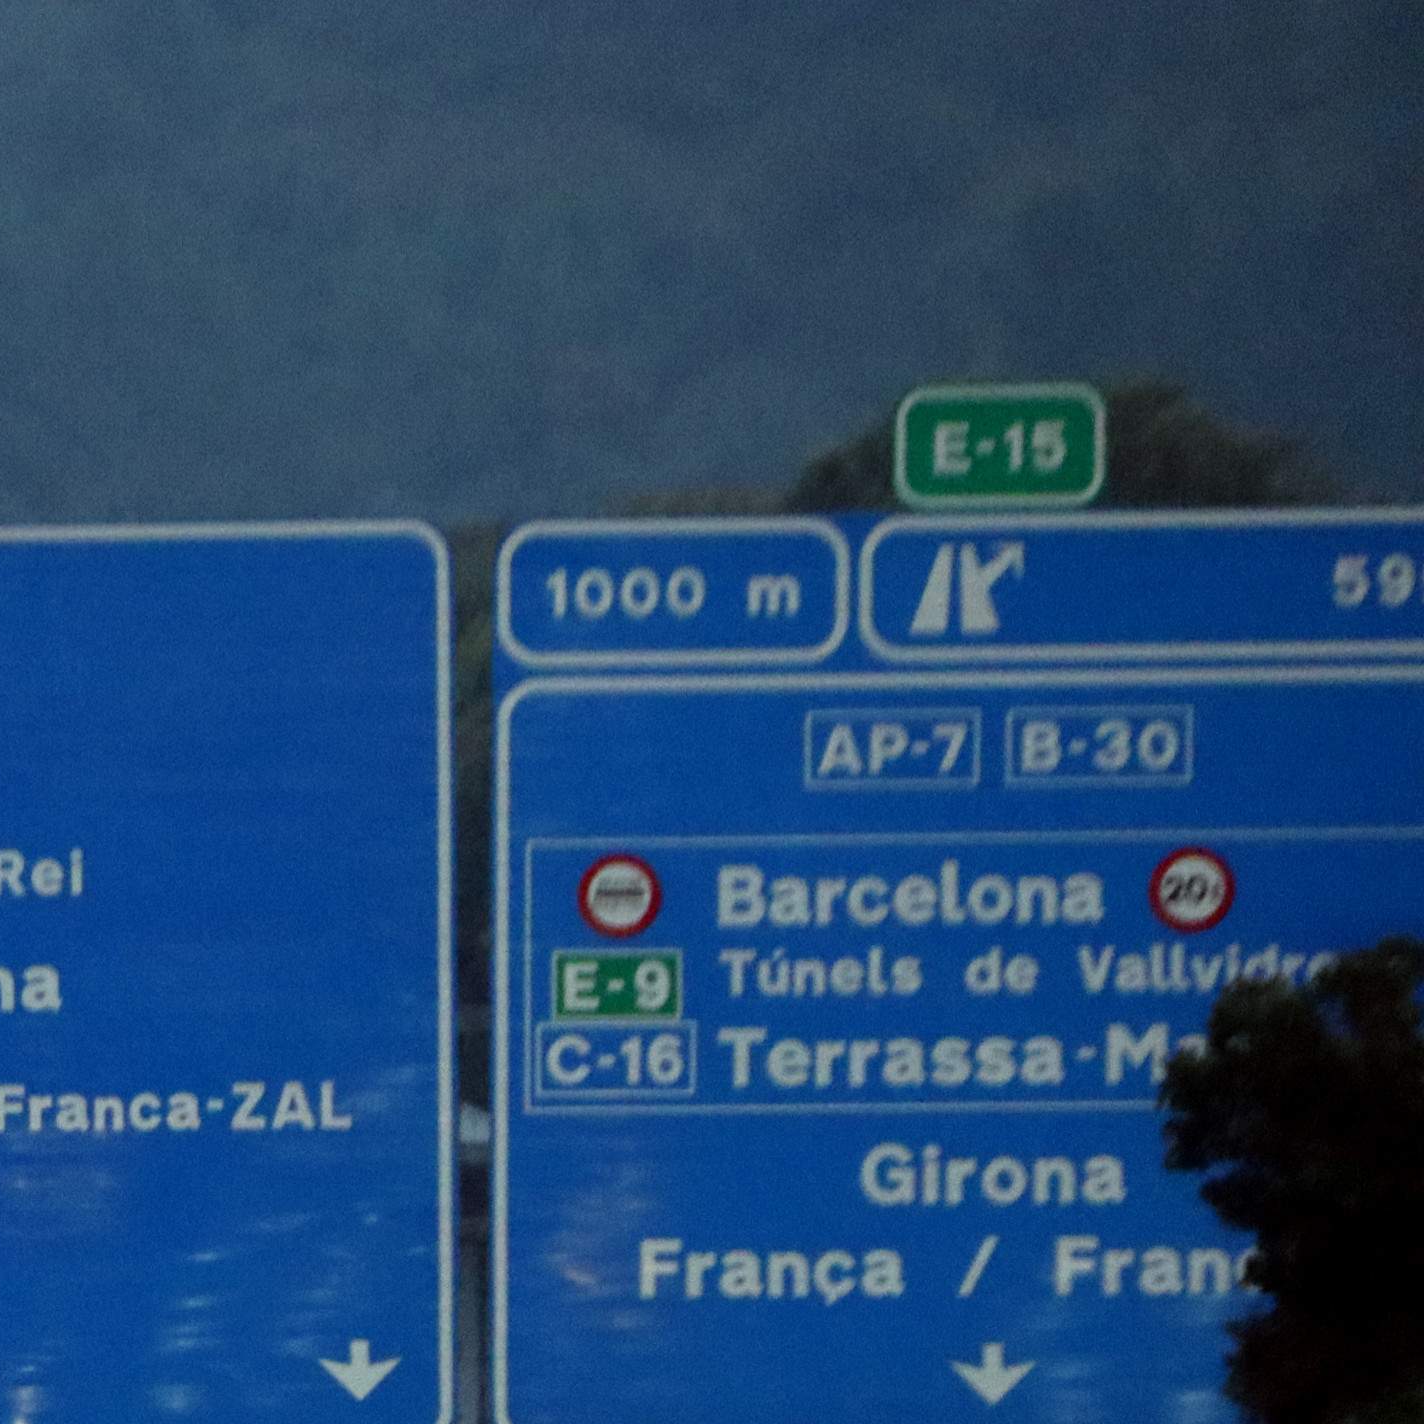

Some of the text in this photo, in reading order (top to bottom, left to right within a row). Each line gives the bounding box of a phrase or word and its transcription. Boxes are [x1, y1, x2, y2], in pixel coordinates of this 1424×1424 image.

[932, 420, 1068, 475] E-15
[545, 565, 802, 620] 1000 m
[1331, 551, 1424, 608] 59
[817, 721, 968, 777] AP-7
[1020, 717, 1179, 774] B-30
[716, 858, 1105, 929] Barcelona
[561, 957, 672, 1014] E-9
[718, 945, 924, 997] Túnels
[963, 945, 1042, 996] de
[545, 1032, 685, 1087] C-16
[859, 1141, 1127, 1207] Girona
[637, 1236, 906, 1306] França
